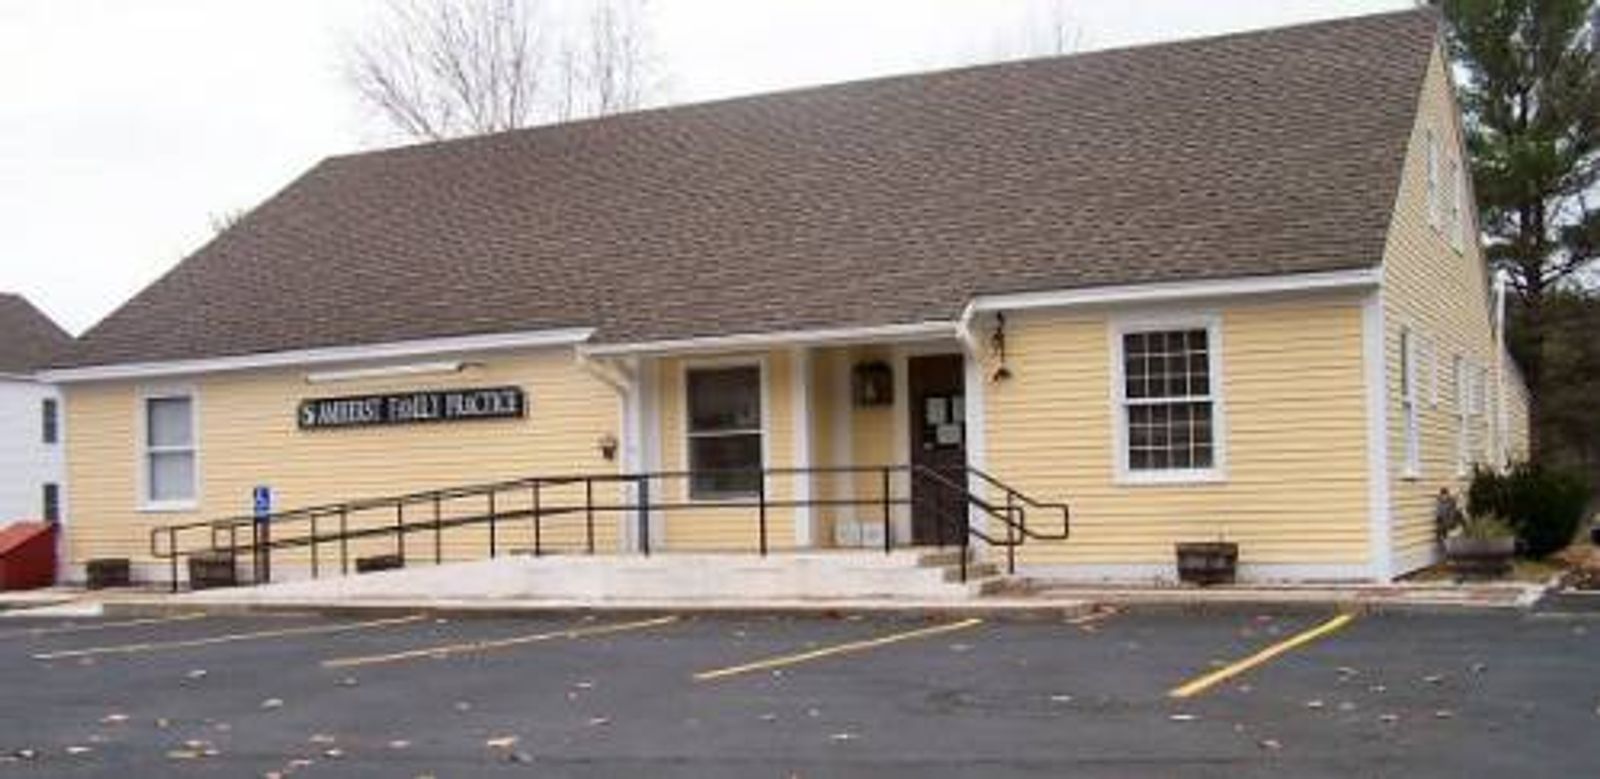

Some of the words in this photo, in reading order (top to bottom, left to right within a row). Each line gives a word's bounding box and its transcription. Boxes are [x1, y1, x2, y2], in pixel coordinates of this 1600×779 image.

[317, 398, 381, 424] AMHERST
[388, 394, 439, 420] FAMILY
[445, 391, 517, 416] PRACTICE
